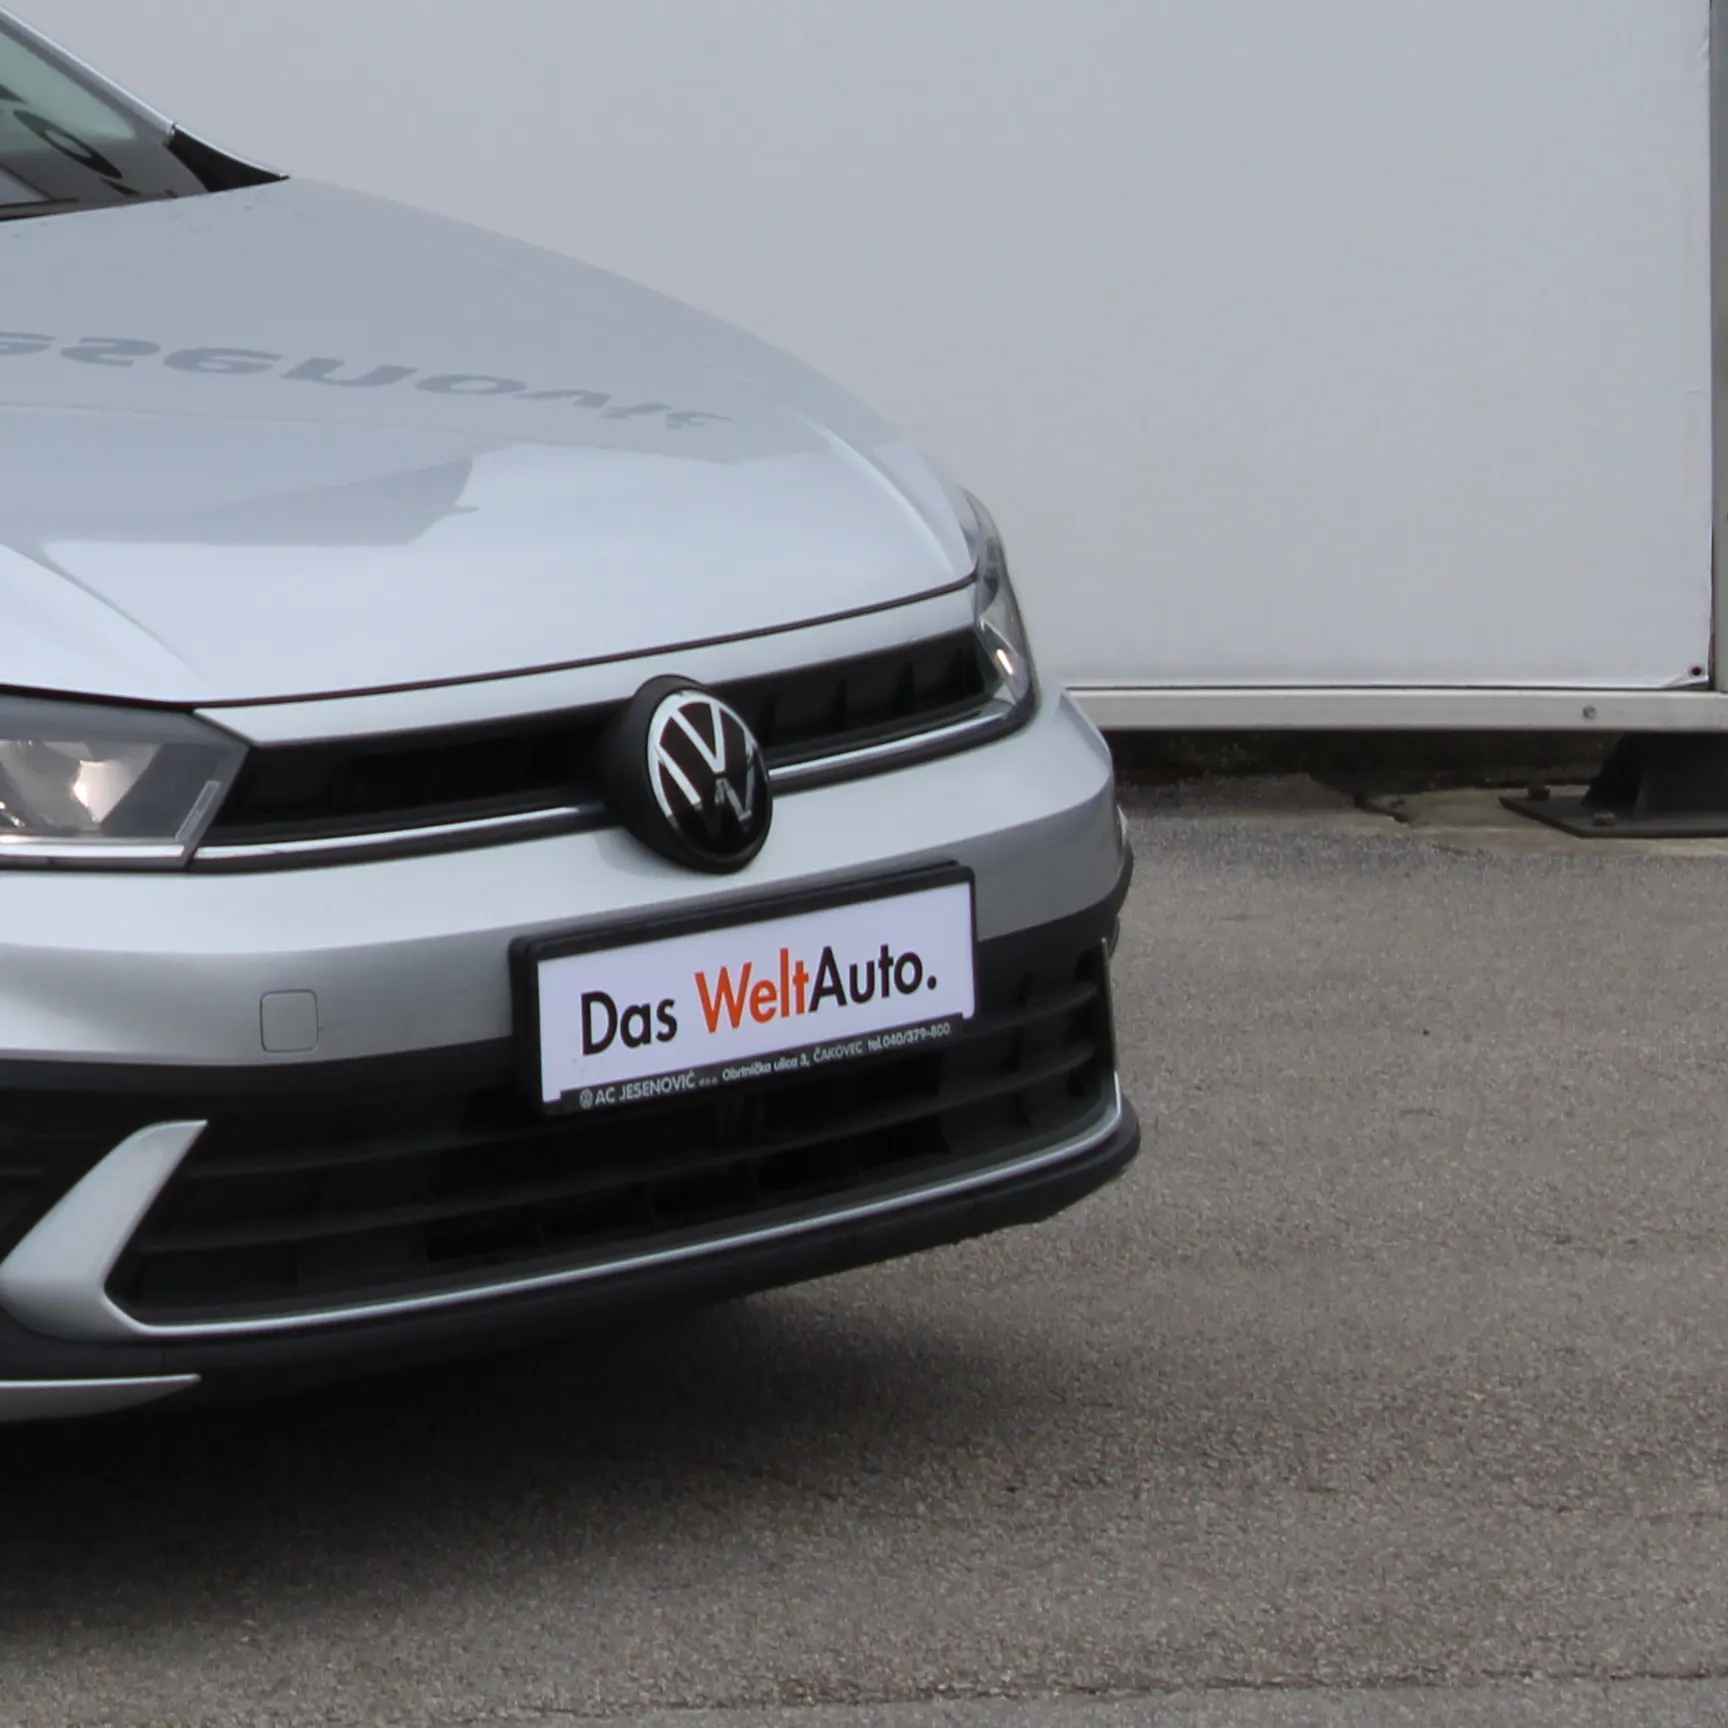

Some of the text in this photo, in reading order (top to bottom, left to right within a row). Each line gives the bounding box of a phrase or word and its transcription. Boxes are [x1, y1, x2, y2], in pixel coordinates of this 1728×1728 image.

[581, 944, 938, 1056] Das WeltAuto.
[595, 1087, 616, 1106] AC
[619, 1070, 696, 1101] JESENOVIĆ
[813, 1041, 863, 1063] ČAKOVEC
